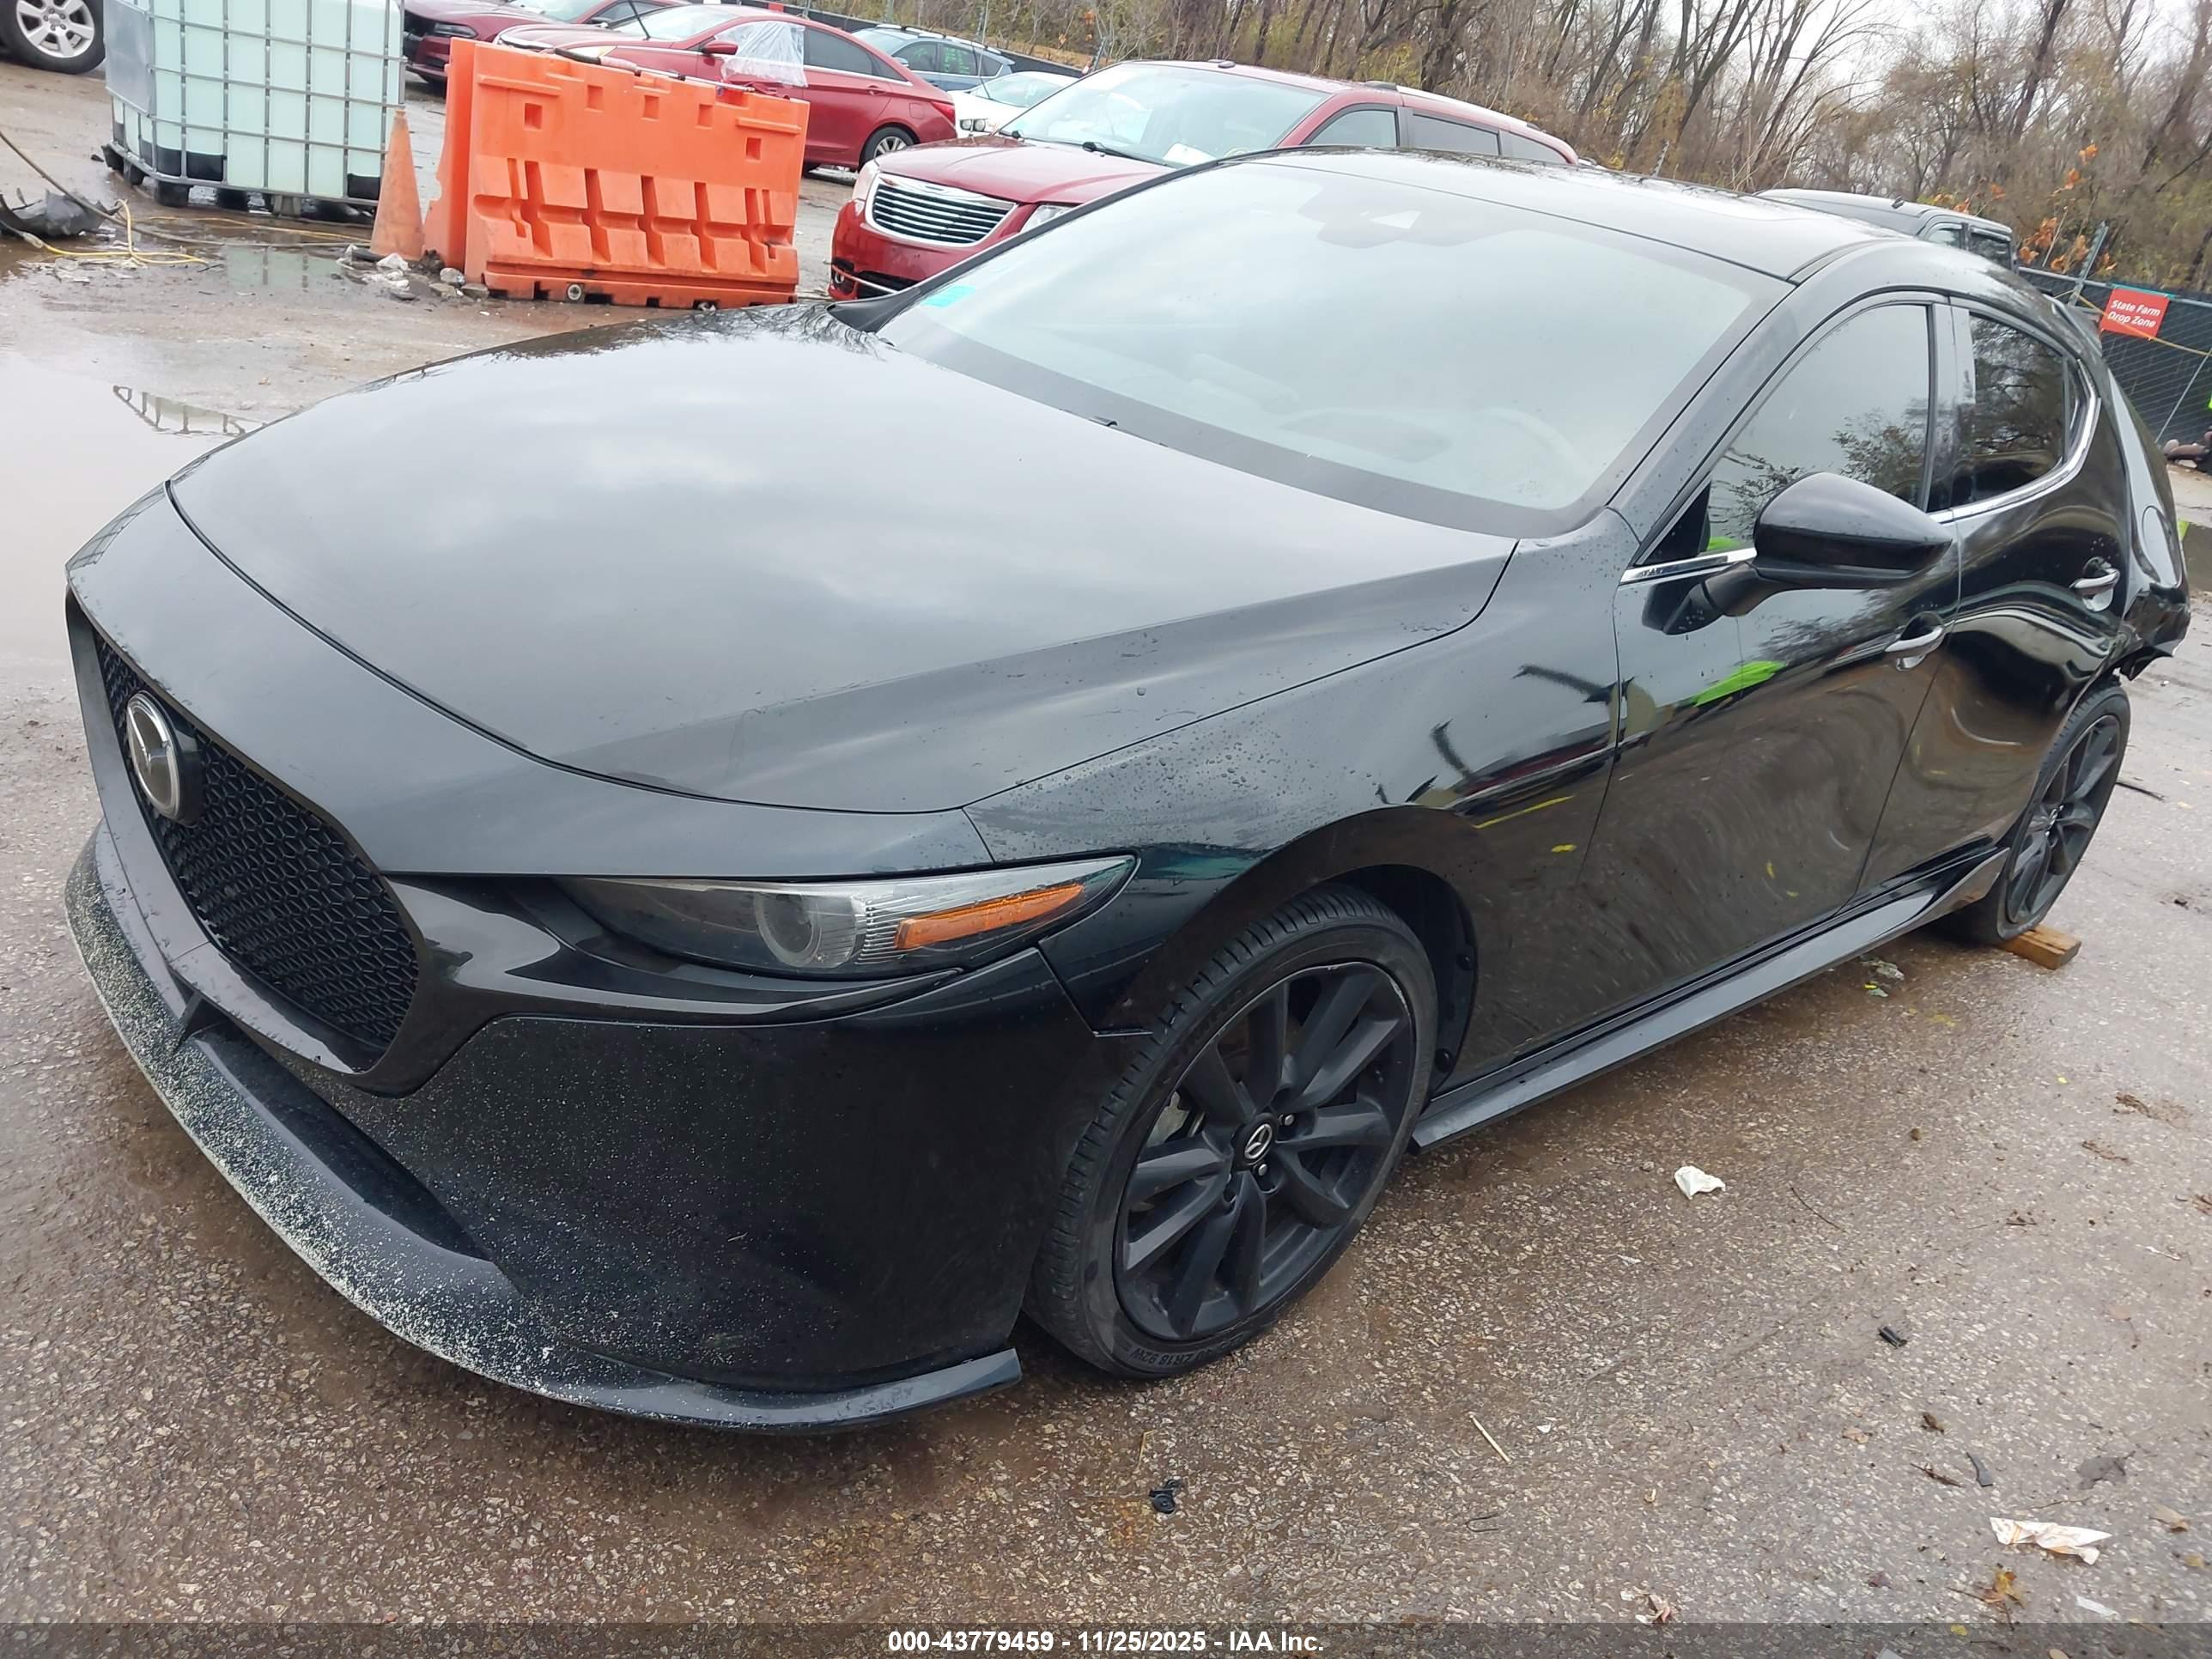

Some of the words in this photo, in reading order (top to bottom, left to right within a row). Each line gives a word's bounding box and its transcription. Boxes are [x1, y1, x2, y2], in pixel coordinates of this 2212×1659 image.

[2111, 300, 2136, 312] State
[2136, 305, 2160, 316] Farm
[2107, 311, 2130, 324] Drop
[2131, 315, 2156, 328] Zone
